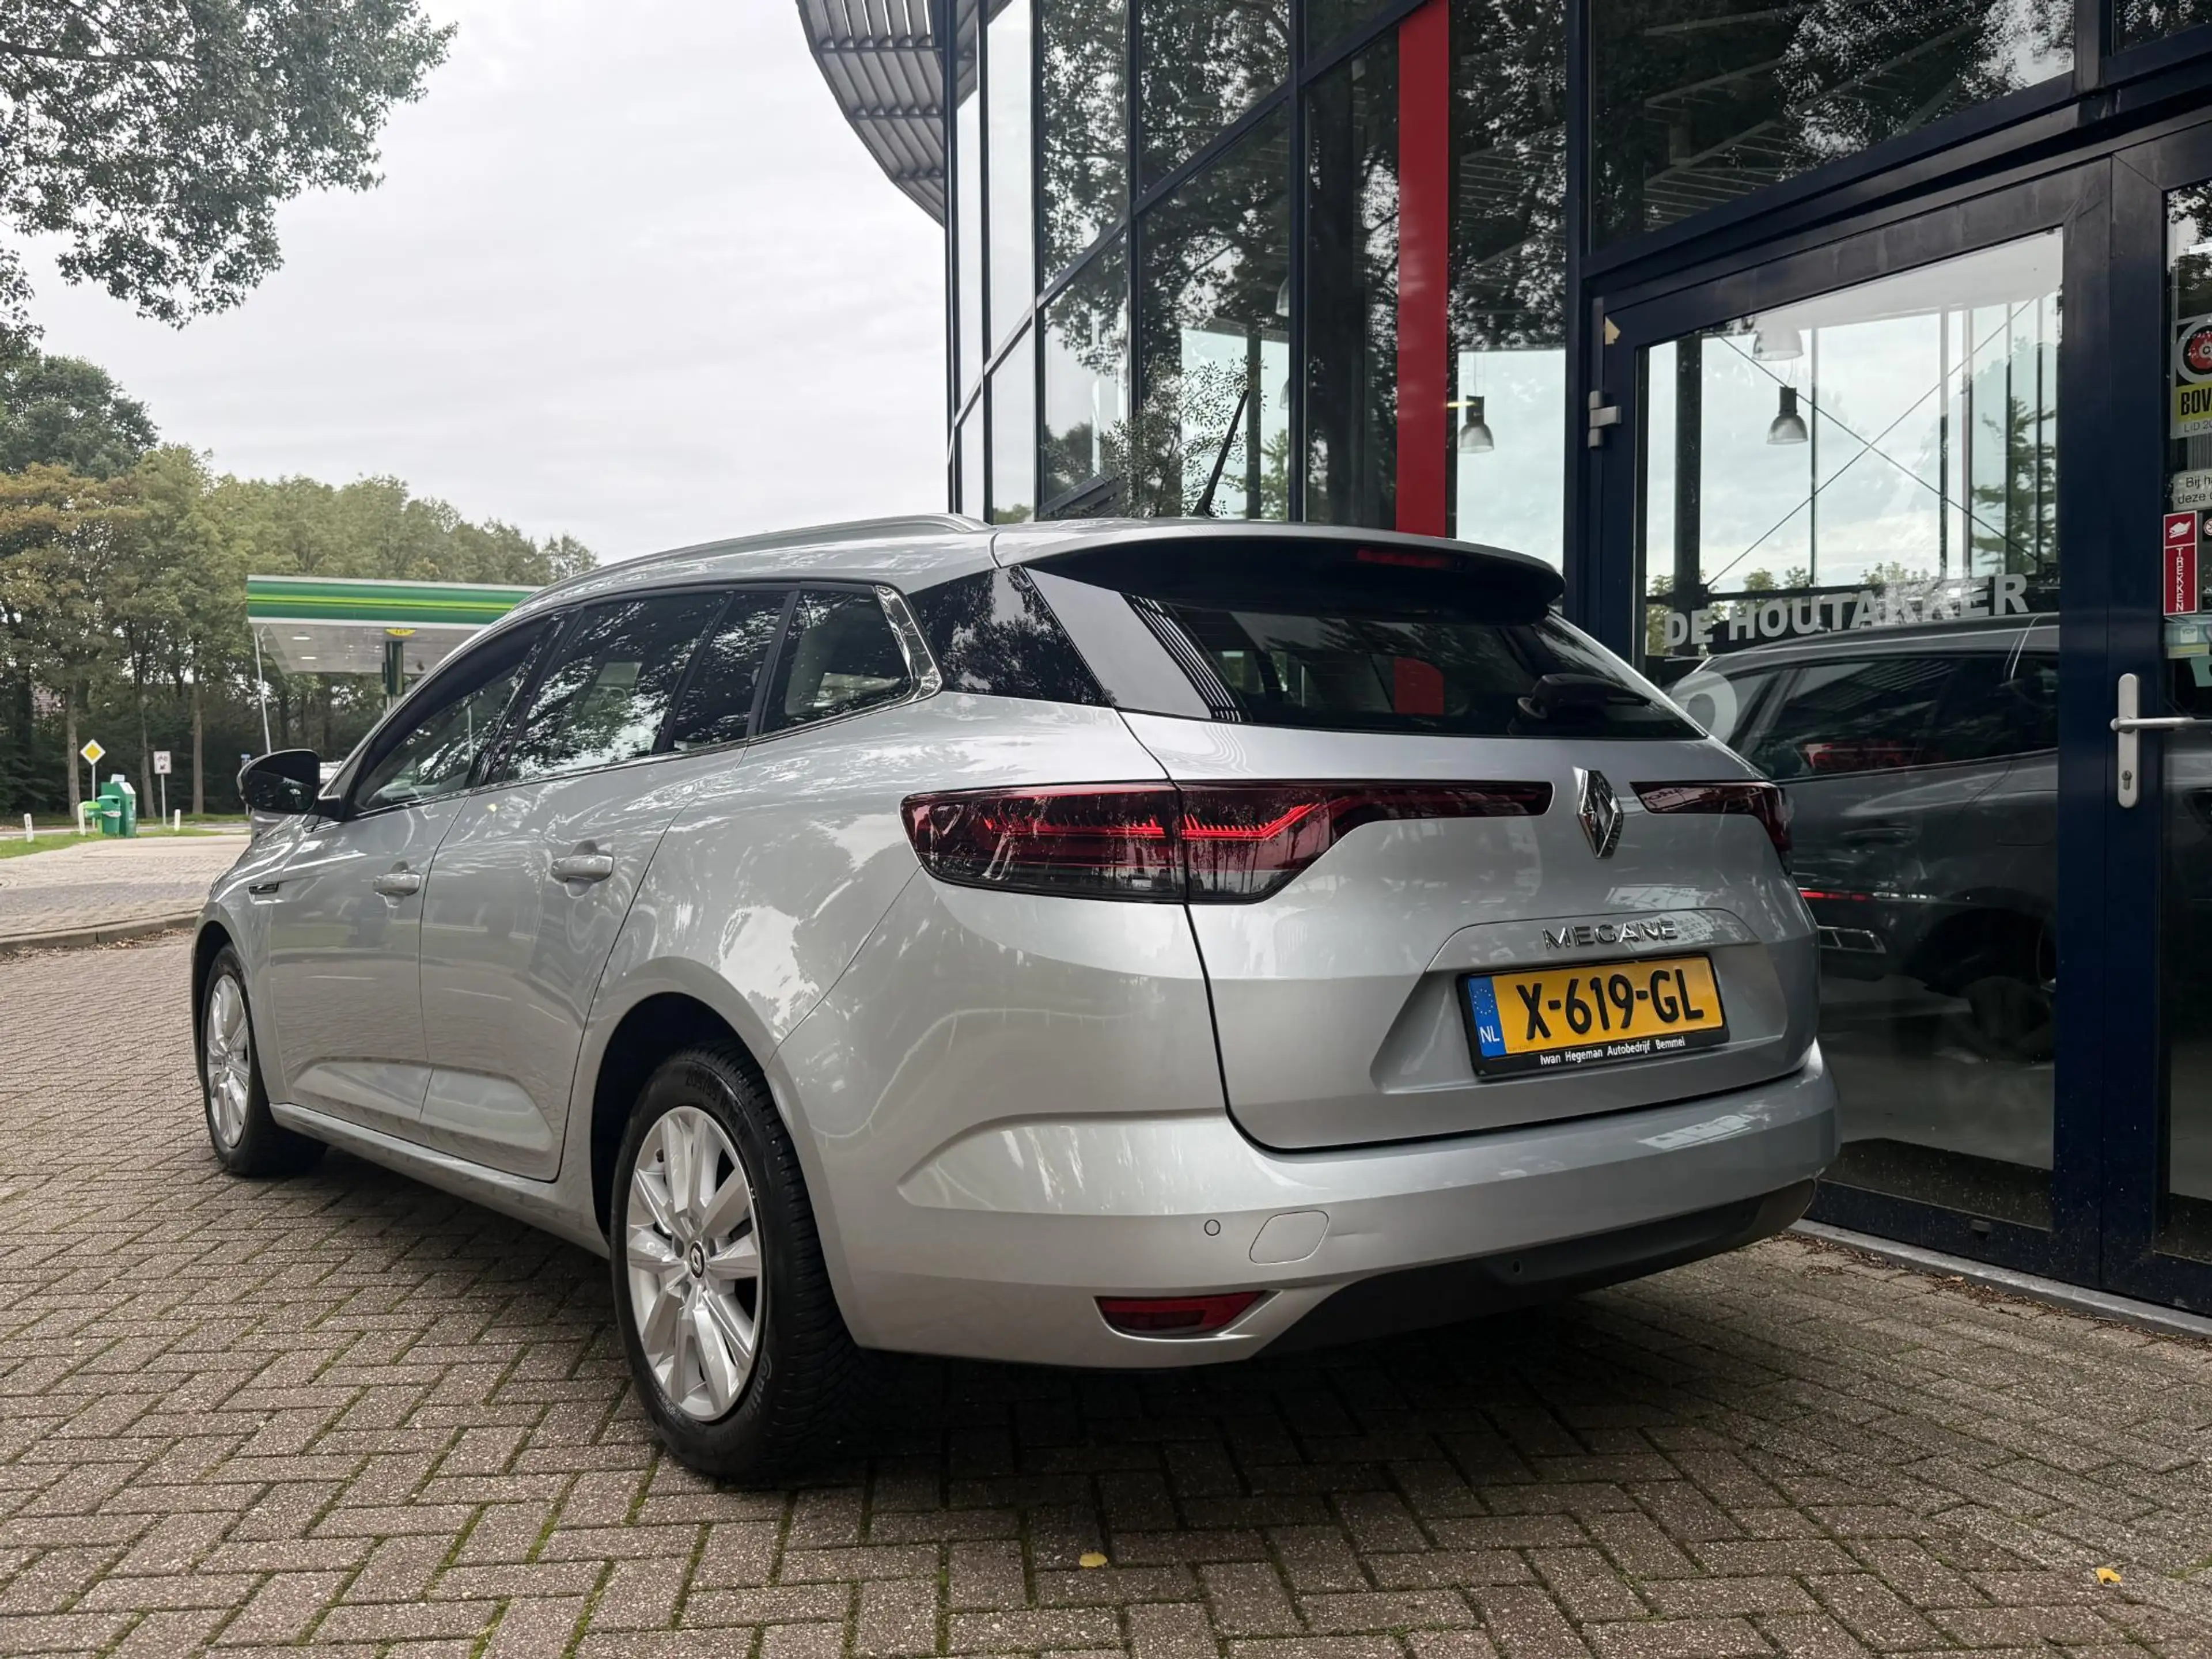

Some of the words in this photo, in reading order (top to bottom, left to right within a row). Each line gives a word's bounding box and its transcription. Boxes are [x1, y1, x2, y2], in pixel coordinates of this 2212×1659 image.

[2180, 387, 2212, 416] BOV
[2186, 476, 2200, 489] Bij
[2177, 493, 2206, 505] deze
[2176, 547, 2184, 612] TREKKEN
[1663, 608, 1714, 647] DE
[1729, 574, 2030, 641] HOUTAKKER
[1542, 919, 1678, 950] MEGANE
[1516, 968, 1704, 1041] X-619-GL
[1479, 1025, 1500, 1044] NL
[1540, 1054, 1561, 1066] Iwan
[1565, 1049, 1603, 1063] Hegeman
[1607, 1040, 1650, 1055] Autobedrijf
[1655, 1036, 1686, 1050] Bemmel
